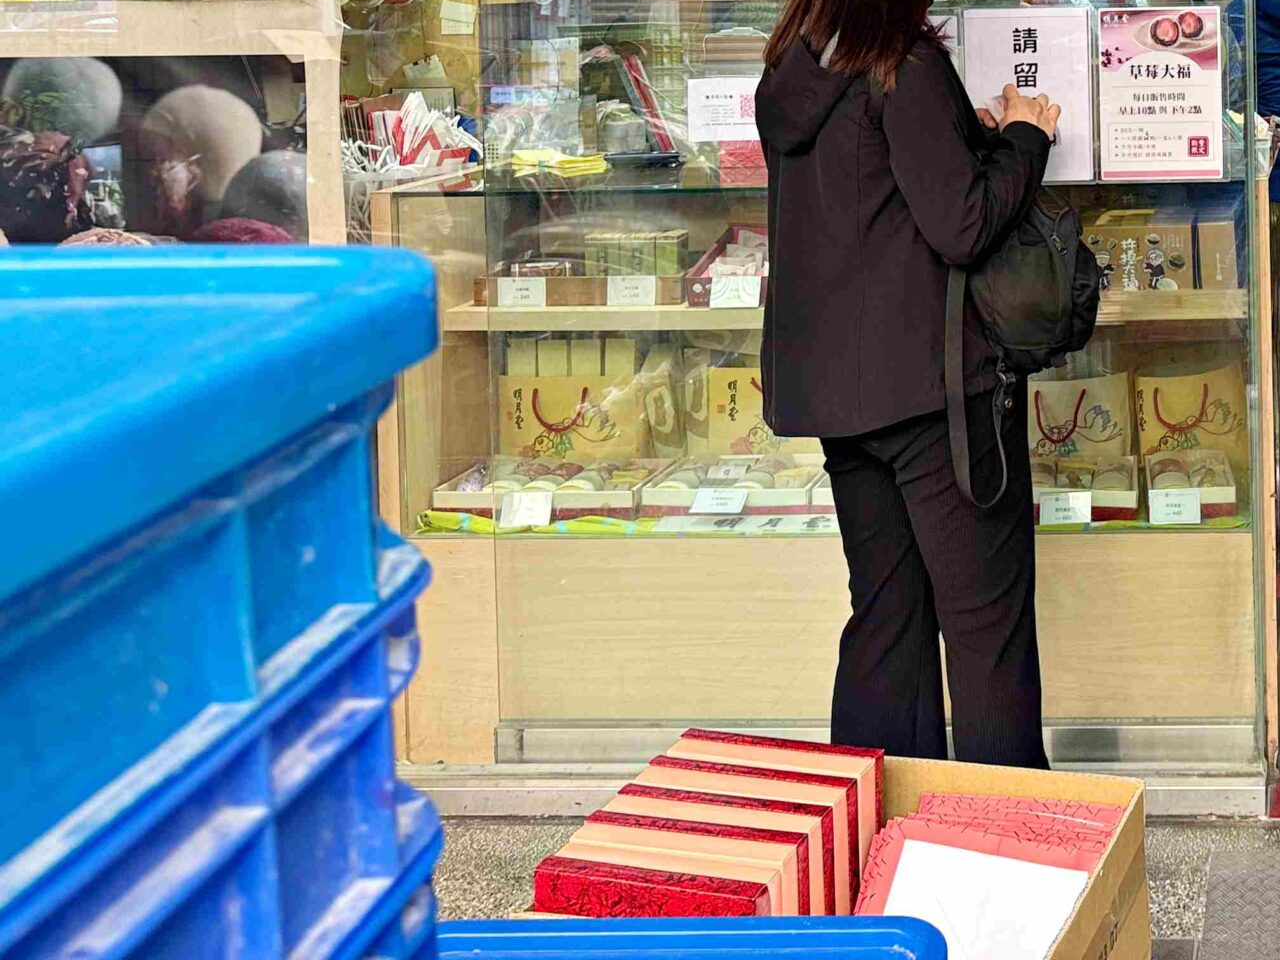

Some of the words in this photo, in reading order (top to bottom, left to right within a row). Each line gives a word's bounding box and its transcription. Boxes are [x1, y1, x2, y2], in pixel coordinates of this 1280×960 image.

[1012, 27, 1039, 88] 請留
[1130, 64, 1191, 79] 草莓大福
[1120, 107, 1156, 116] 早上10點
[1173, 105, 1202, 114] 下午2點
[513, 388, 524, 430] 明月堂
[727, 380, 739, 421] 明月堂
